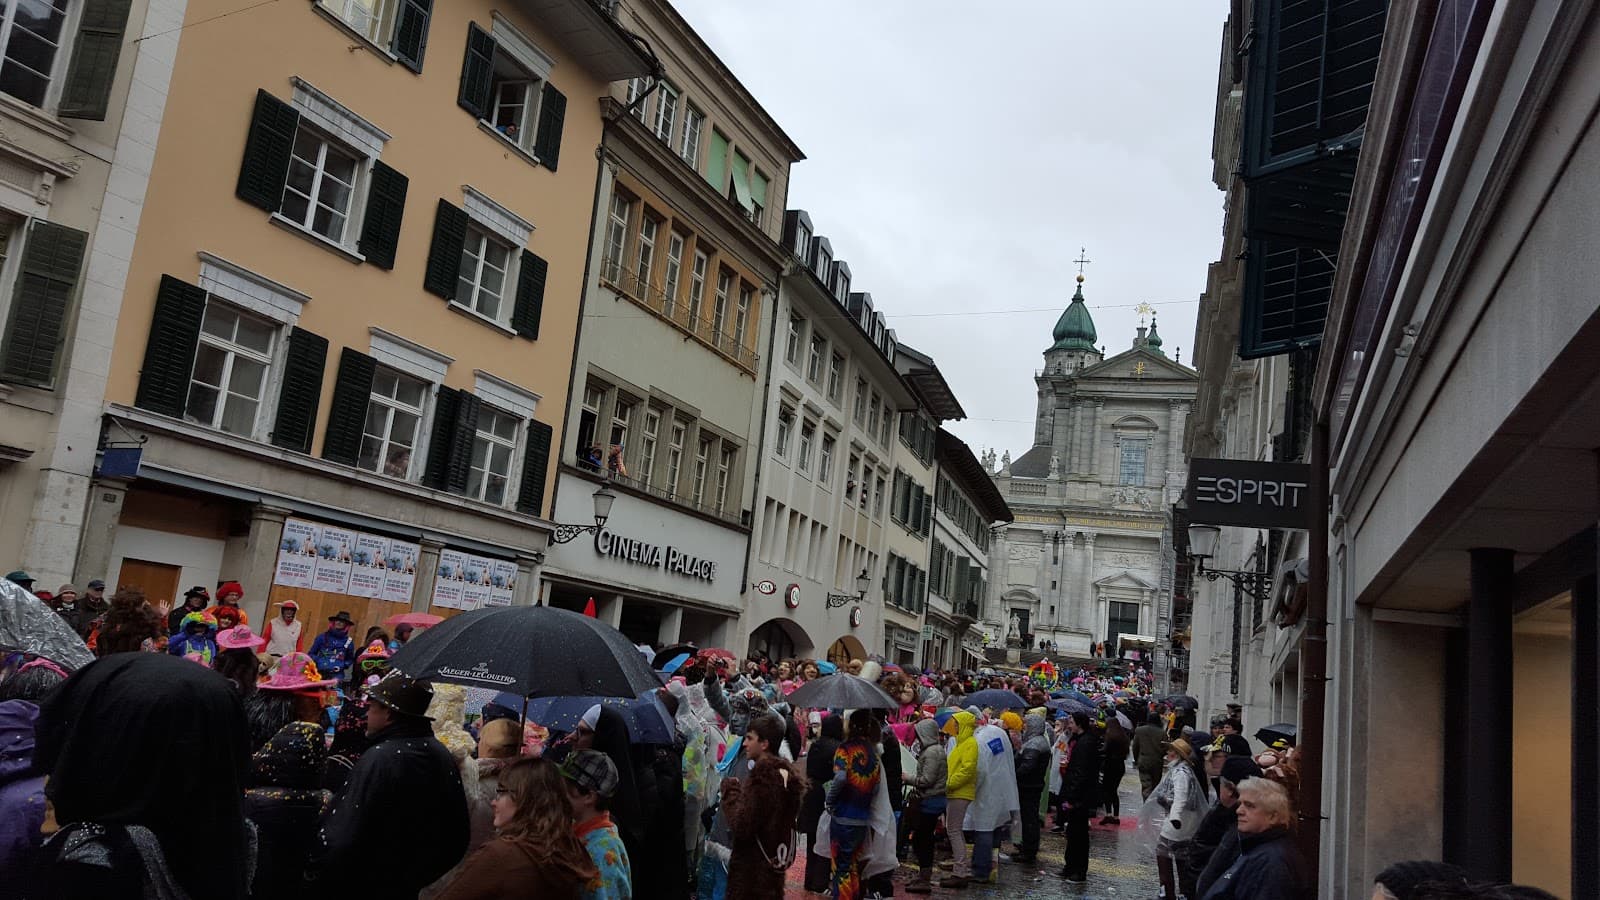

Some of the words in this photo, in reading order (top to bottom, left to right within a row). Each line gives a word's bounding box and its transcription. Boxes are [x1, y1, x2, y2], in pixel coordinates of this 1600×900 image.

[1196, 477, 1307, 507] ESPRIT
[596, 527, 662, 566] CINEMA
[666, 546, 718, 581] PALACE
